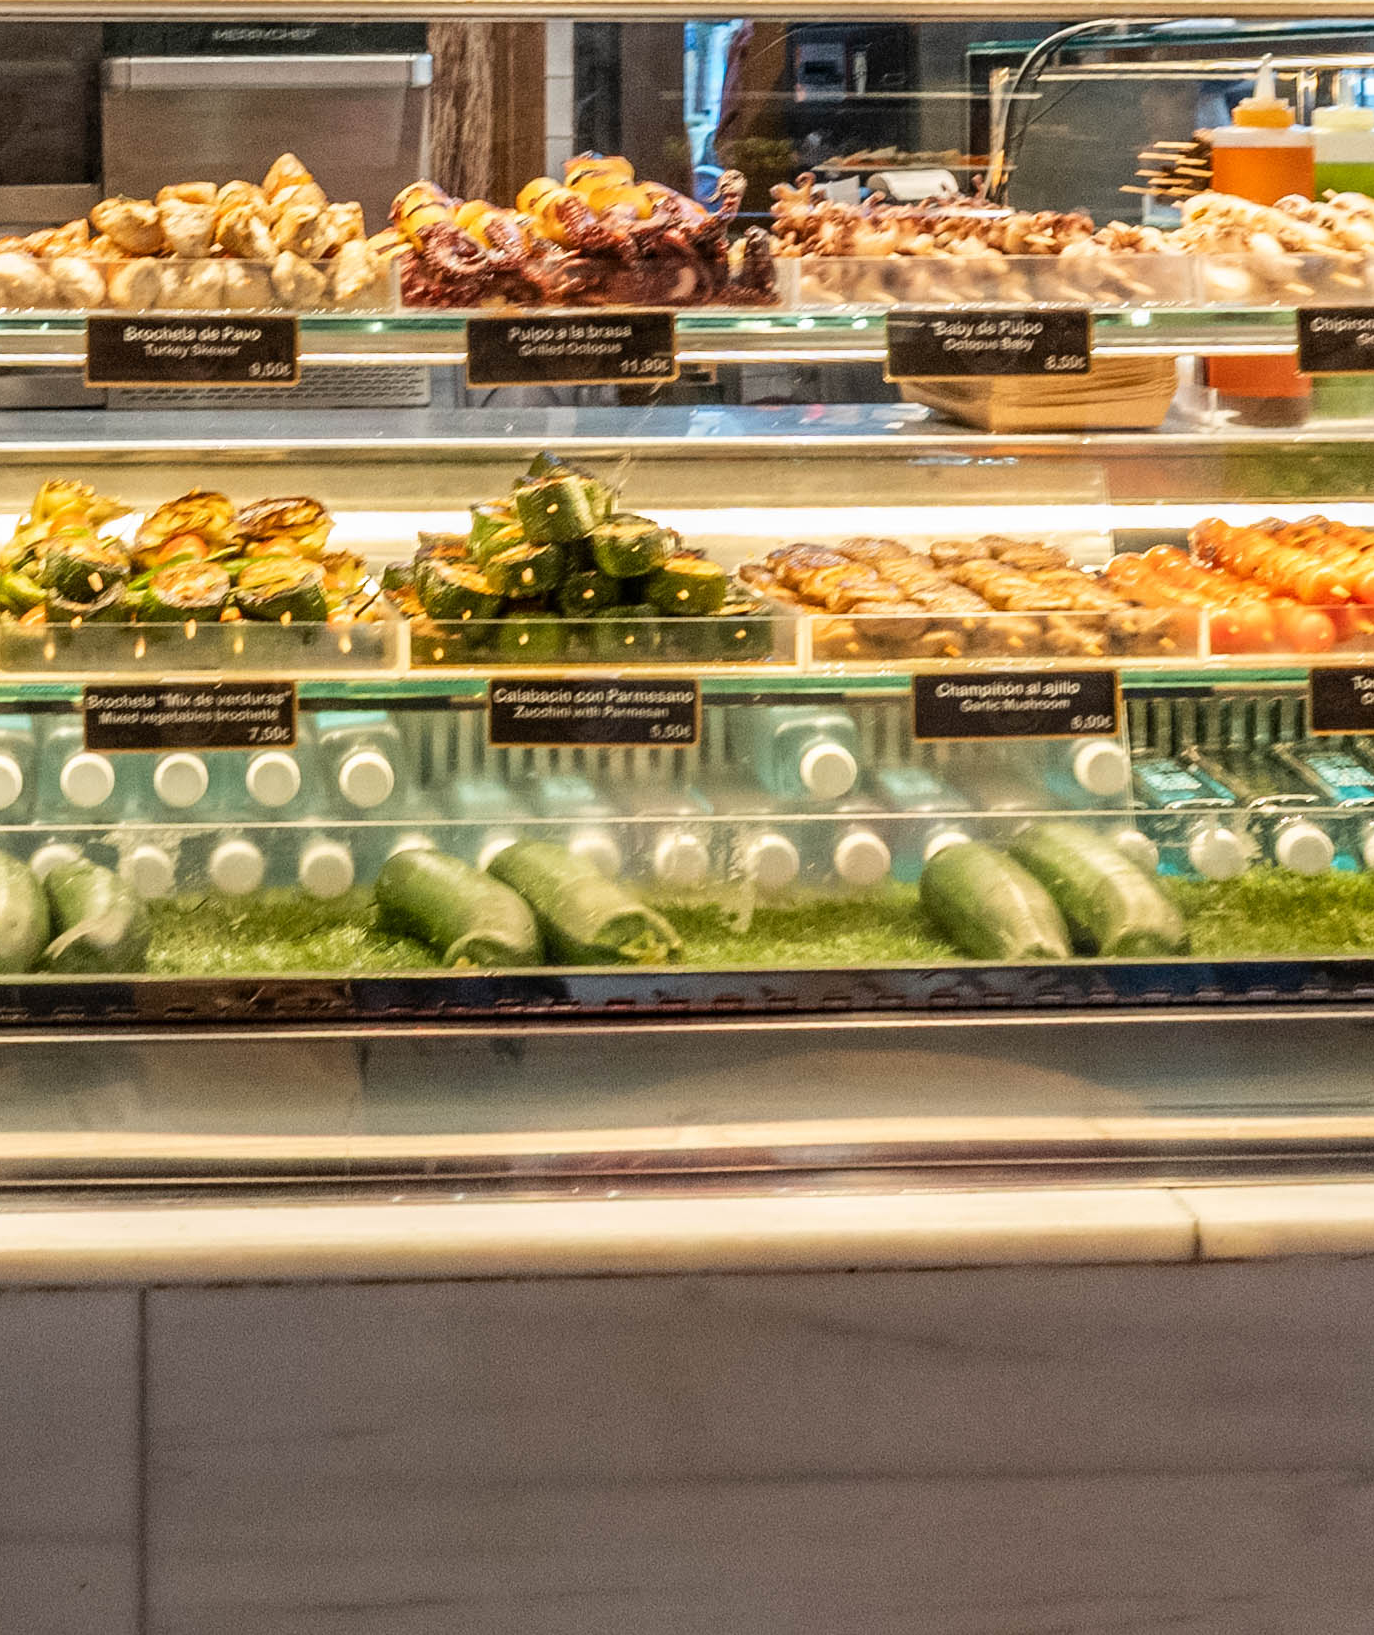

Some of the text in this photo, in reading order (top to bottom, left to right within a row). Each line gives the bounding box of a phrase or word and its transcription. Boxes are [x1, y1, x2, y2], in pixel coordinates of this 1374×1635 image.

[123, 326, 262, 342] Brocheta de Pavo
[508, 324, 632, 342] Pulpo a la brasa
[933, 320, 1044, 339] Baby de Pulpo
[573, 690, 604, 703] con
[605, 688, 694, 703] Parmesano
[1025, 681, 1041, 696] al
[1042, 680, 1081, 698] ajillo
[86, 694, 156, 709] Brocheta
[193, 693, 214, 707] de
